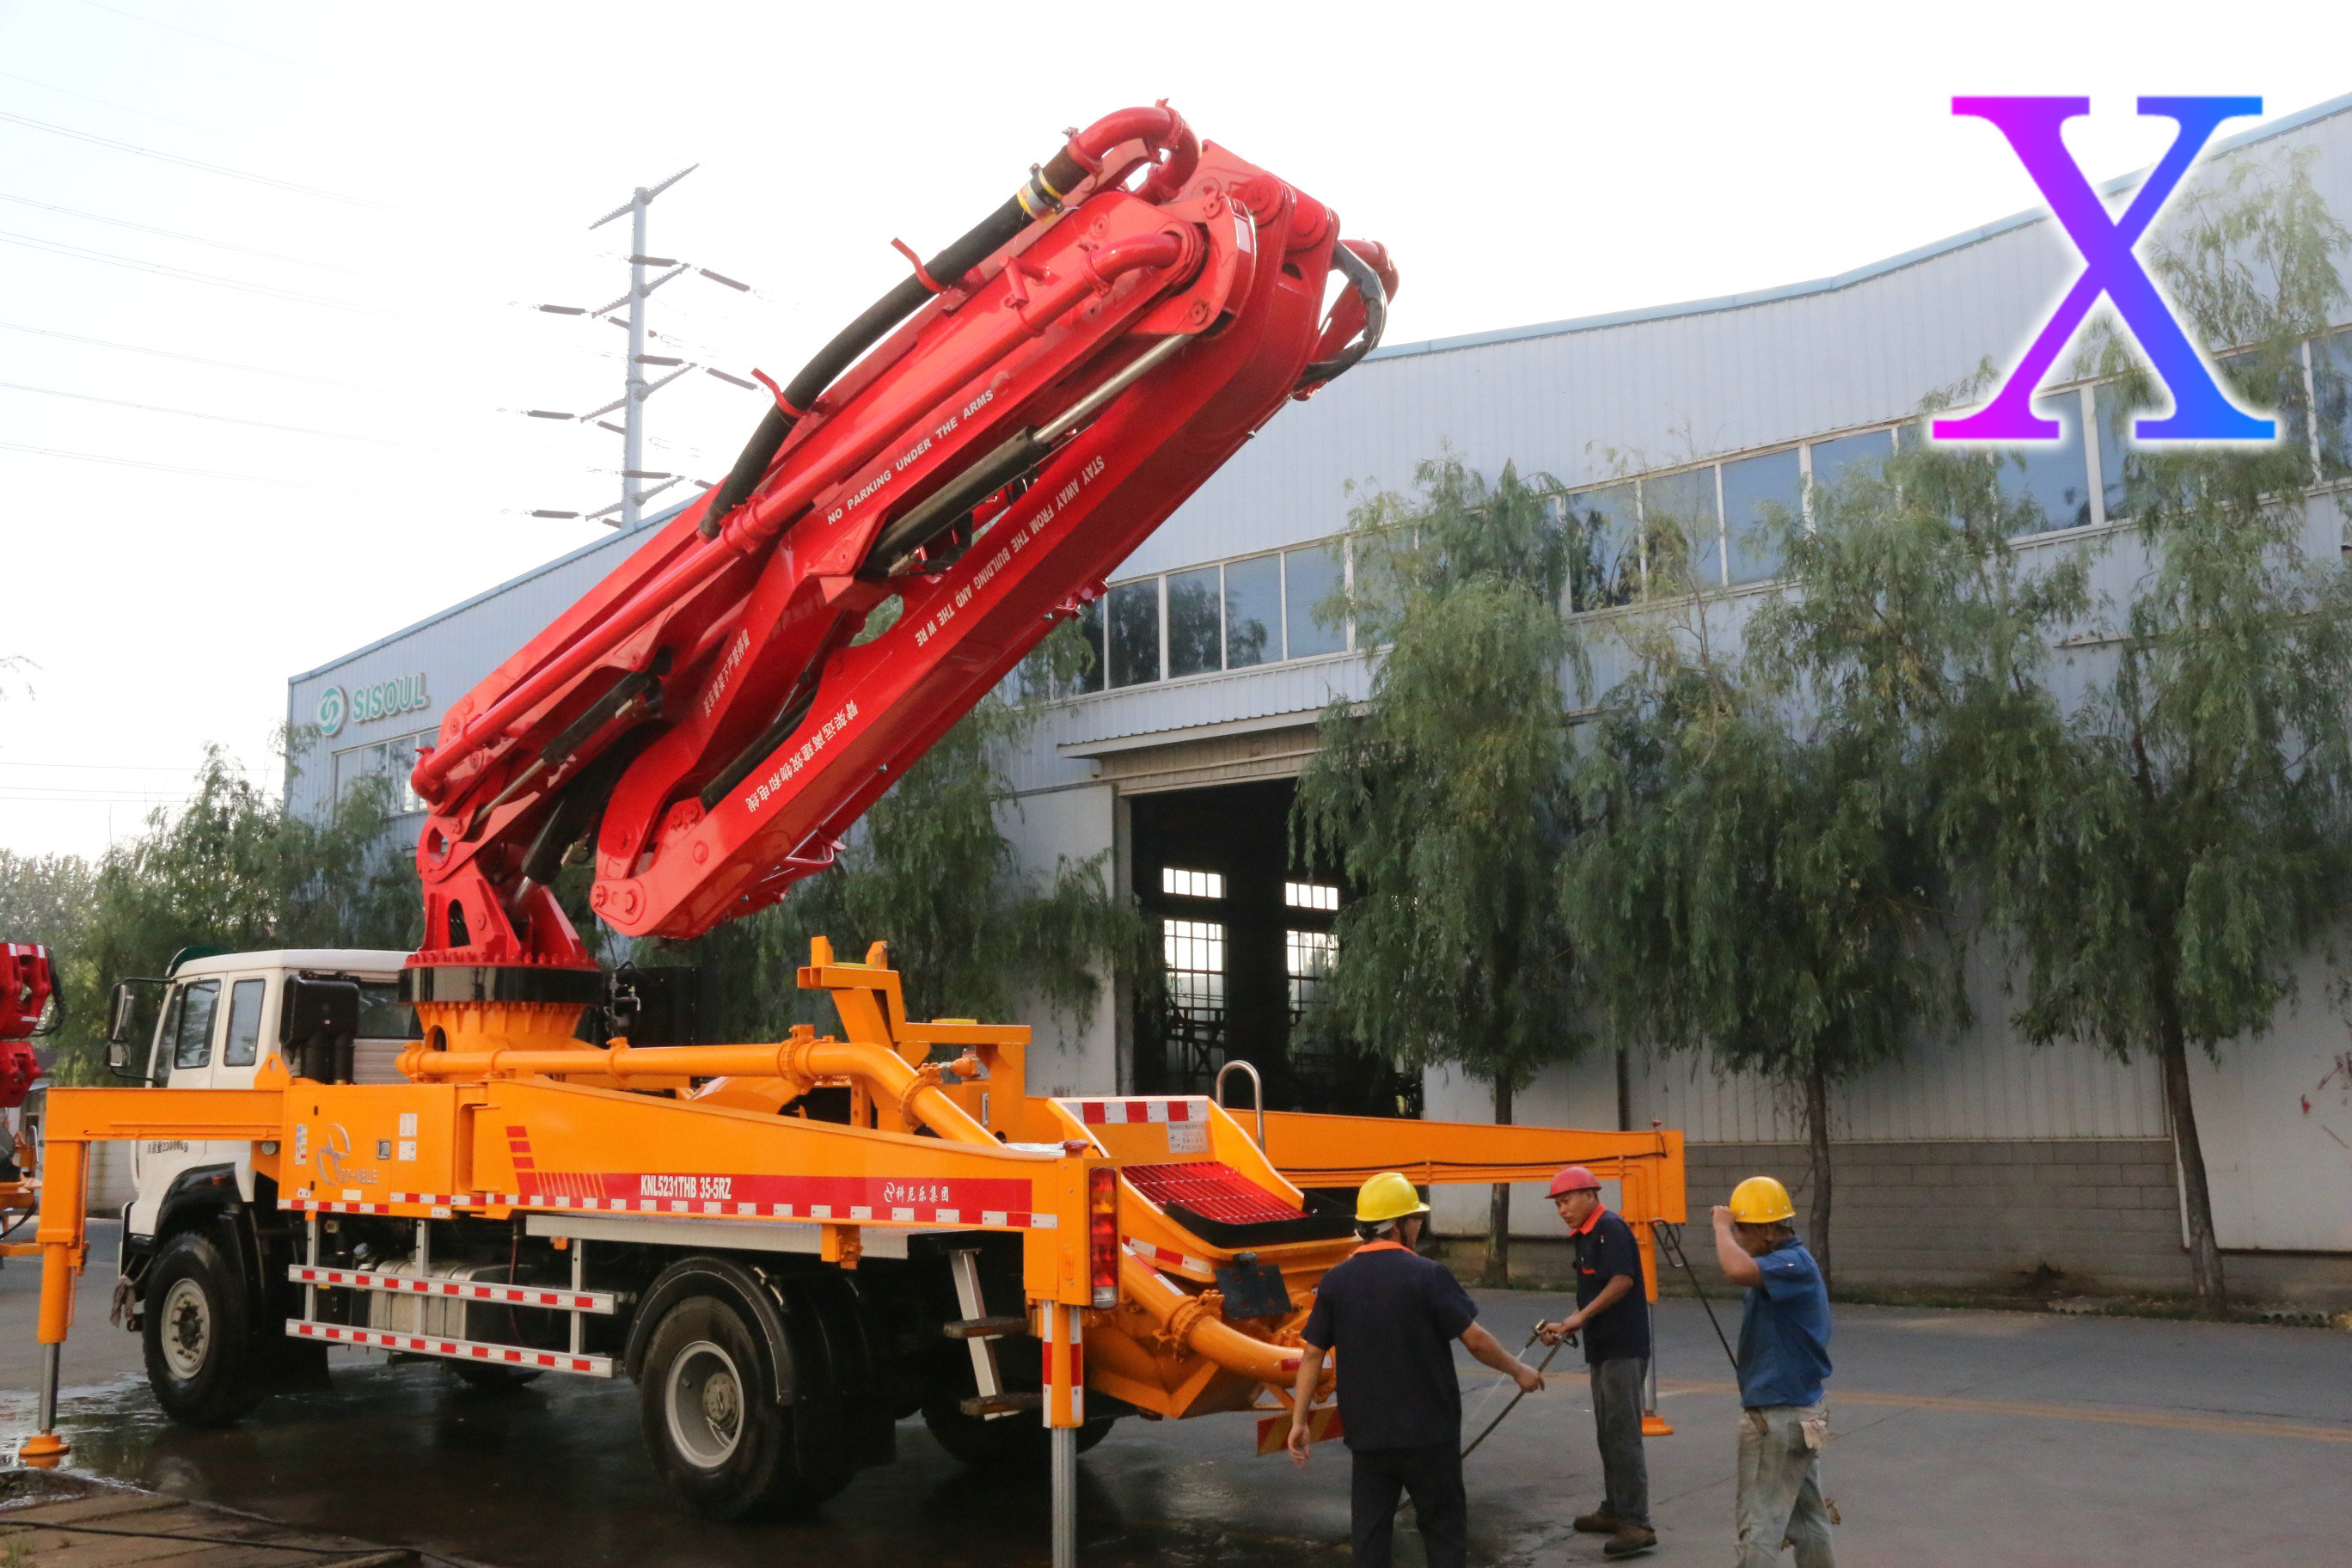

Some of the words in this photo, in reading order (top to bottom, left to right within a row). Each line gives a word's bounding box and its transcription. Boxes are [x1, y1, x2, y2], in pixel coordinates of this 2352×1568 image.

[828, 508, 842, 525] NO
[847, 469, 891, 510] PARKING
[896, 438, 932, 471] UNDER
[935, 417, 959, 439] THE
[962, 389, 995, 420] ARMS
[1082, 456, 1105, 485] STAY
[1057, 479, 1080, 511] AWAY
[1029, 504, 1055, 535] FROM
[1010, 530, 1029, 553] THE
[973, 547, 1010, 590] BUILDING
[955, 584, 973, 609] AND
[935, 603, 956, 627] THE
[353, 673, 429, 724] SISOUL
[745, 699, 859, 813] 臂架远离建筑物和电线
[640, 1174, 697, 1199] KNL5231THB
[699, 1177, 732, 1200] 35-5RZ
[895, 1185, 950, 1204] 科尼乐集团
